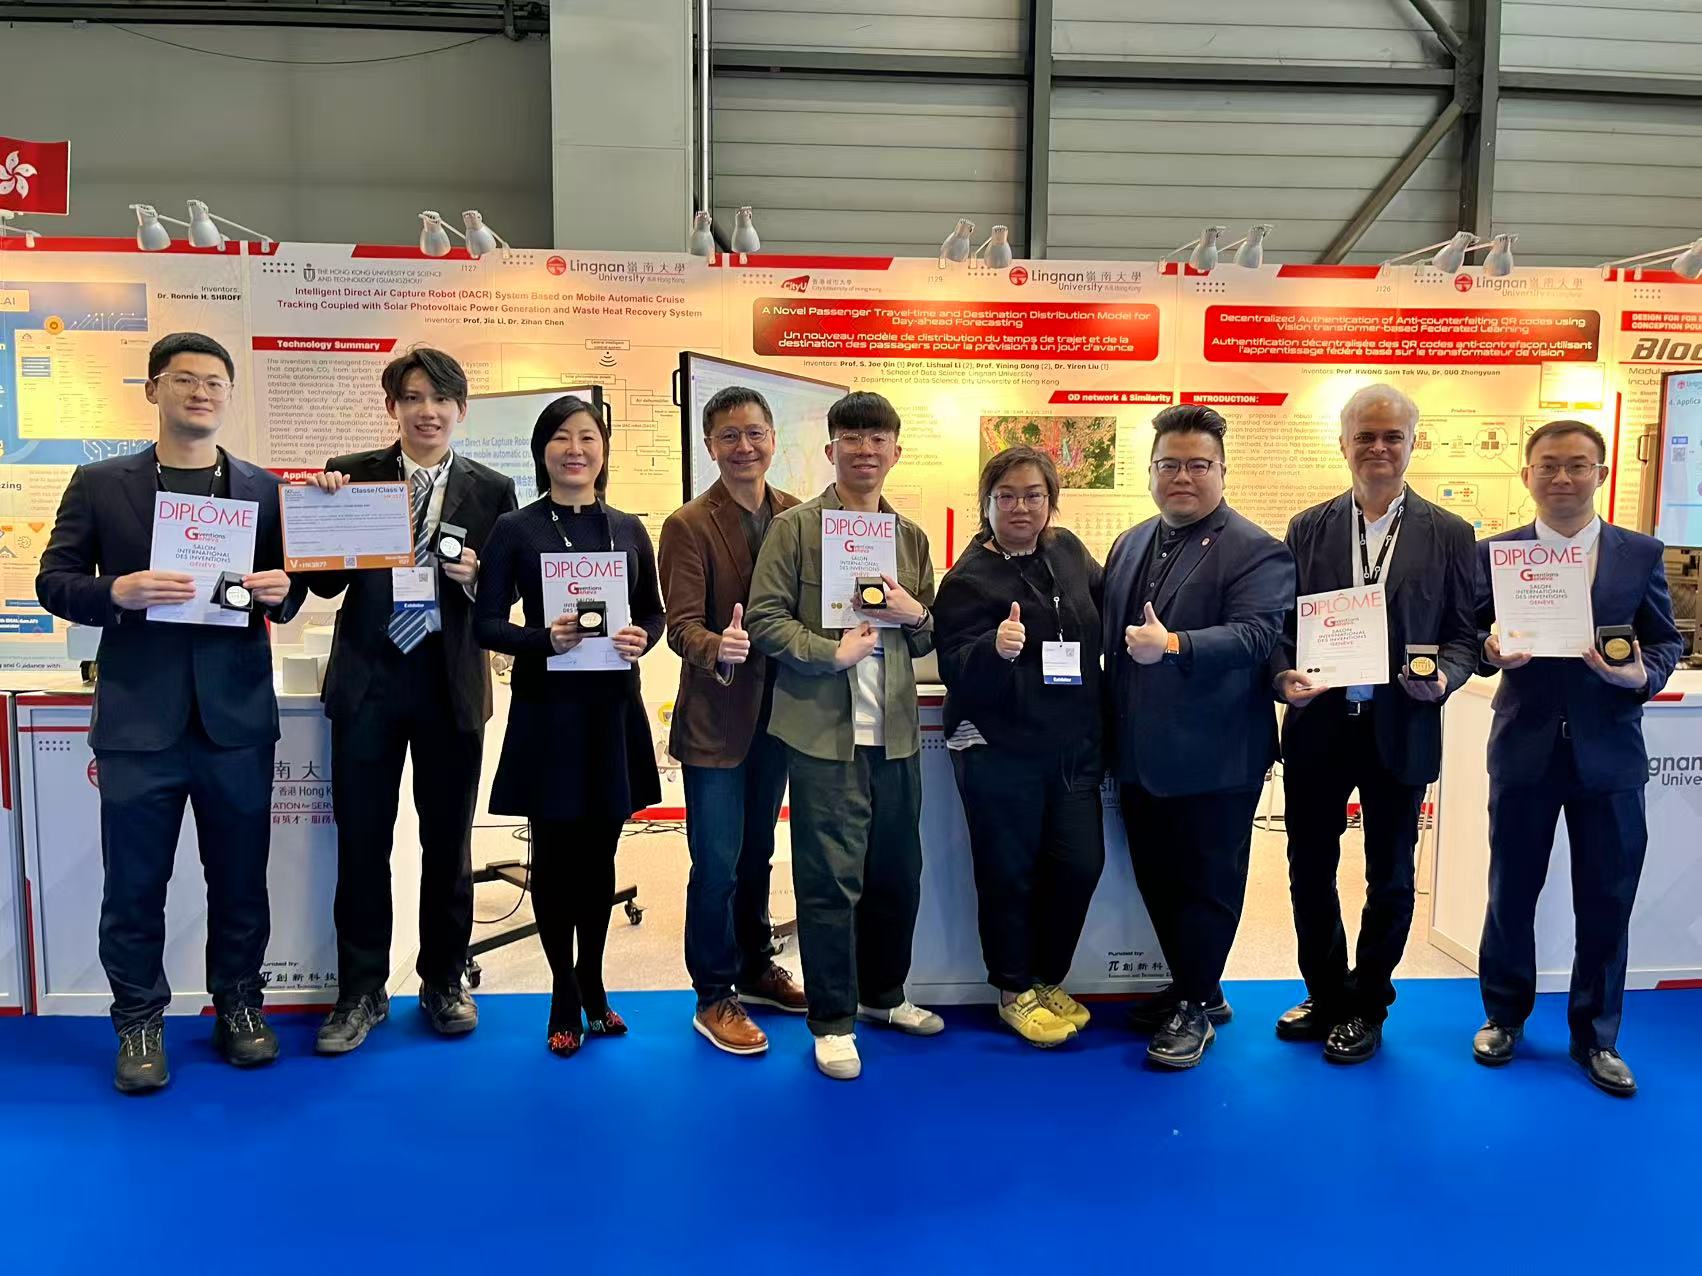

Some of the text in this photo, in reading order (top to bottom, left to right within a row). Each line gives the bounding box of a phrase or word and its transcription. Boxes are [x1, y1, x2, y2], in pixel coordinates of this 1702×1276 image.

[570, 260, 624, 274] Lingnan
[628, 262, 685, 274] 嶺南大學
[599, 273, 645, 283] University
[1032, 270, 1084, 284] Lingnan
[1086, 272, 1141, 282] 嶺南大學
[201, 285, 238, 293] Inventors:
[1059, 282, 1102, 292] University
[1477, 277, 1526, 290] Lingnan
[158, 292, 168, 300] Dr.
[296, 288, 342, 297] Intelligent
[345, 288, 371, 296] Direct
[390, 290, 426, 299] Capture
[429, 290, 456, 298] Robot
[458, 290, 492, 299] (DACR)
[495, 292, 528, 302] System
[531, 293, 560, 301] Based
[576, 293, 606, 301] Mobile
[608, 294, 653, 303] Automatic
[656, 295, 685, 303] Cruise
[278, 300, 318, 310] Tracking
[321, 301, 359, 310] Coupled
[362, 302, 381, 310] with
[410, 303, 467, 312] Photovoltaic
[470, 304, 498, 312] Power
[501, 305, 550, 313] Generation
[553, 306, 569, 314] and
[626, 308, 666, 317] Recovery
[670, 309, 702, 318] System
[774, 307, 806, 315] Novel
[809, 308, 871, 317] Passenger
[874, 308, 938, 317] Travel-time
[963, 310, 1027, 319] Destination
[1030, 311, 1094, 320] Distribution
[1098, 312, 1132, 320] Model
[1134, 312, 1151, 320] for
[892, 317, 1023, 328] Day-ahead Forecasting
[1220, 314, 1295, 322] Decentralized
[1298, 316, 1378, 324] Authentication
[1382, 316, 1393, 324] of
[1396, 317, 1498, 326] Anti-counterfeiting
[1555, 318, 1586, 327] using
[1632, 314, 1661, 322] DESIGN
[1664, 314, 1679, 322] FOR
[1314, 324, 1417, 332] transformer-based
[1421, 325, 1477, 333] Federated
[1480, 326, 1529, 334] Learning
[784, 331, 800, 339] Un
[803, 332, 854, 340] nouveau
[857, 332, 898, 340] modèle
[901, 333, 914, 341] de
[918, 334, 982, 342] distribution
[1003, 335, 1037, 344] temps
[1040, 335, 1055, 343] de
[1057, 336, 1086, 345] trajet
[1119, 336, 1129, 344] la
[1212, 338, 1300, 346] Authentification
[1302, 339, 1375, 347] décentralisée
[1402, 340, 1417, 348] QR
[1420, 340, 1453, 348] codes
[1456, 341, 1547, 350] anti-contrefaçon
[1550, 341, 1592, 350] utilisant
[277, 340, 380, 351] Technology Summary
[779, 339, 1134, 353] destination des passagers pour la prévision à un jour d'avance
[1239, 346, 1323, 356] l'apprentissage
[1326, 346, 1362, 355] fédéré
[1365, 346, 1391, 355] basé
[1394, 348, 1413, 356] sur
[1416, 348, 1425, 356] le
[1130, 394, 1171, 403] Similarity
[160, 501, 254, 528] DIPLÔME
[825, 515, 892, 538] DIPLÔME
[178, 548, 230, 558] INTERNATIONAL
[1494, 543, 1583, 566] DIPLÔME
[545, 556, 623, 578] DIPLÔME
[1301, 591, 1381, 617] DIPLÔME
[300, 786, 324, 798] Hong
